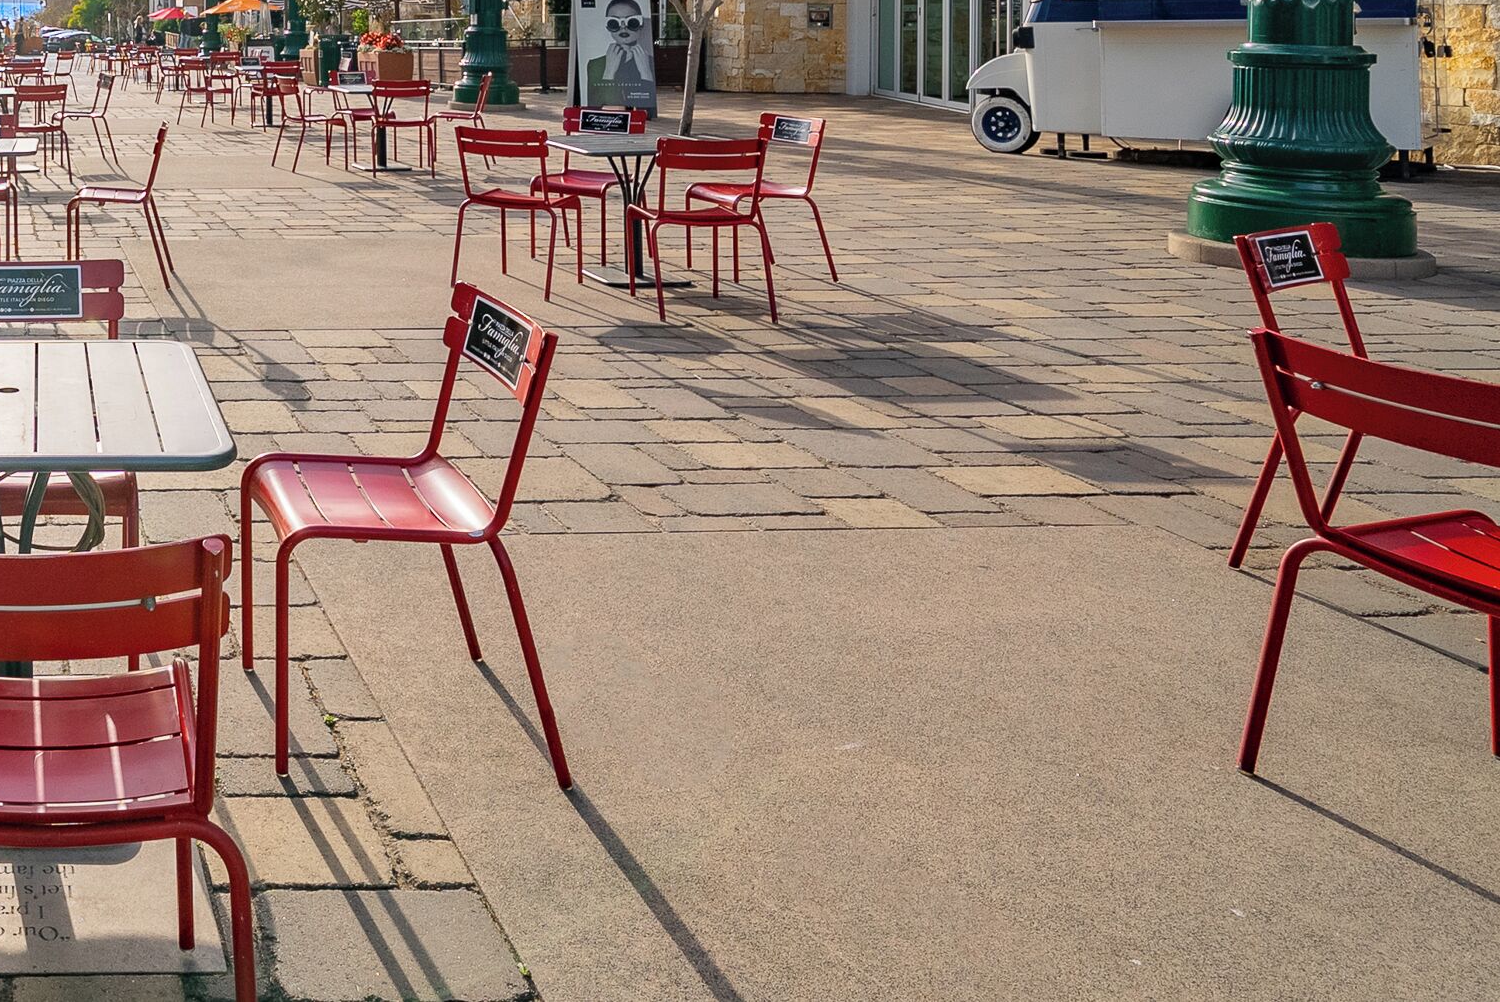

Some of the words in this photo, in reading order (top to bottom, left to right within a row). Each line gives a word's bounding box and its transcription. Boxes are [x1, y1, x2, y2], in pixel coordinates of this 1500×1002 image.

[1265, 239, 1306, 273] Famiglia
[478, 313, 523, 358] Famiglia
[42, 865, 75, 879] the
[25, 884, 73, 899] Let's
[38, 906, 45, 919] I
